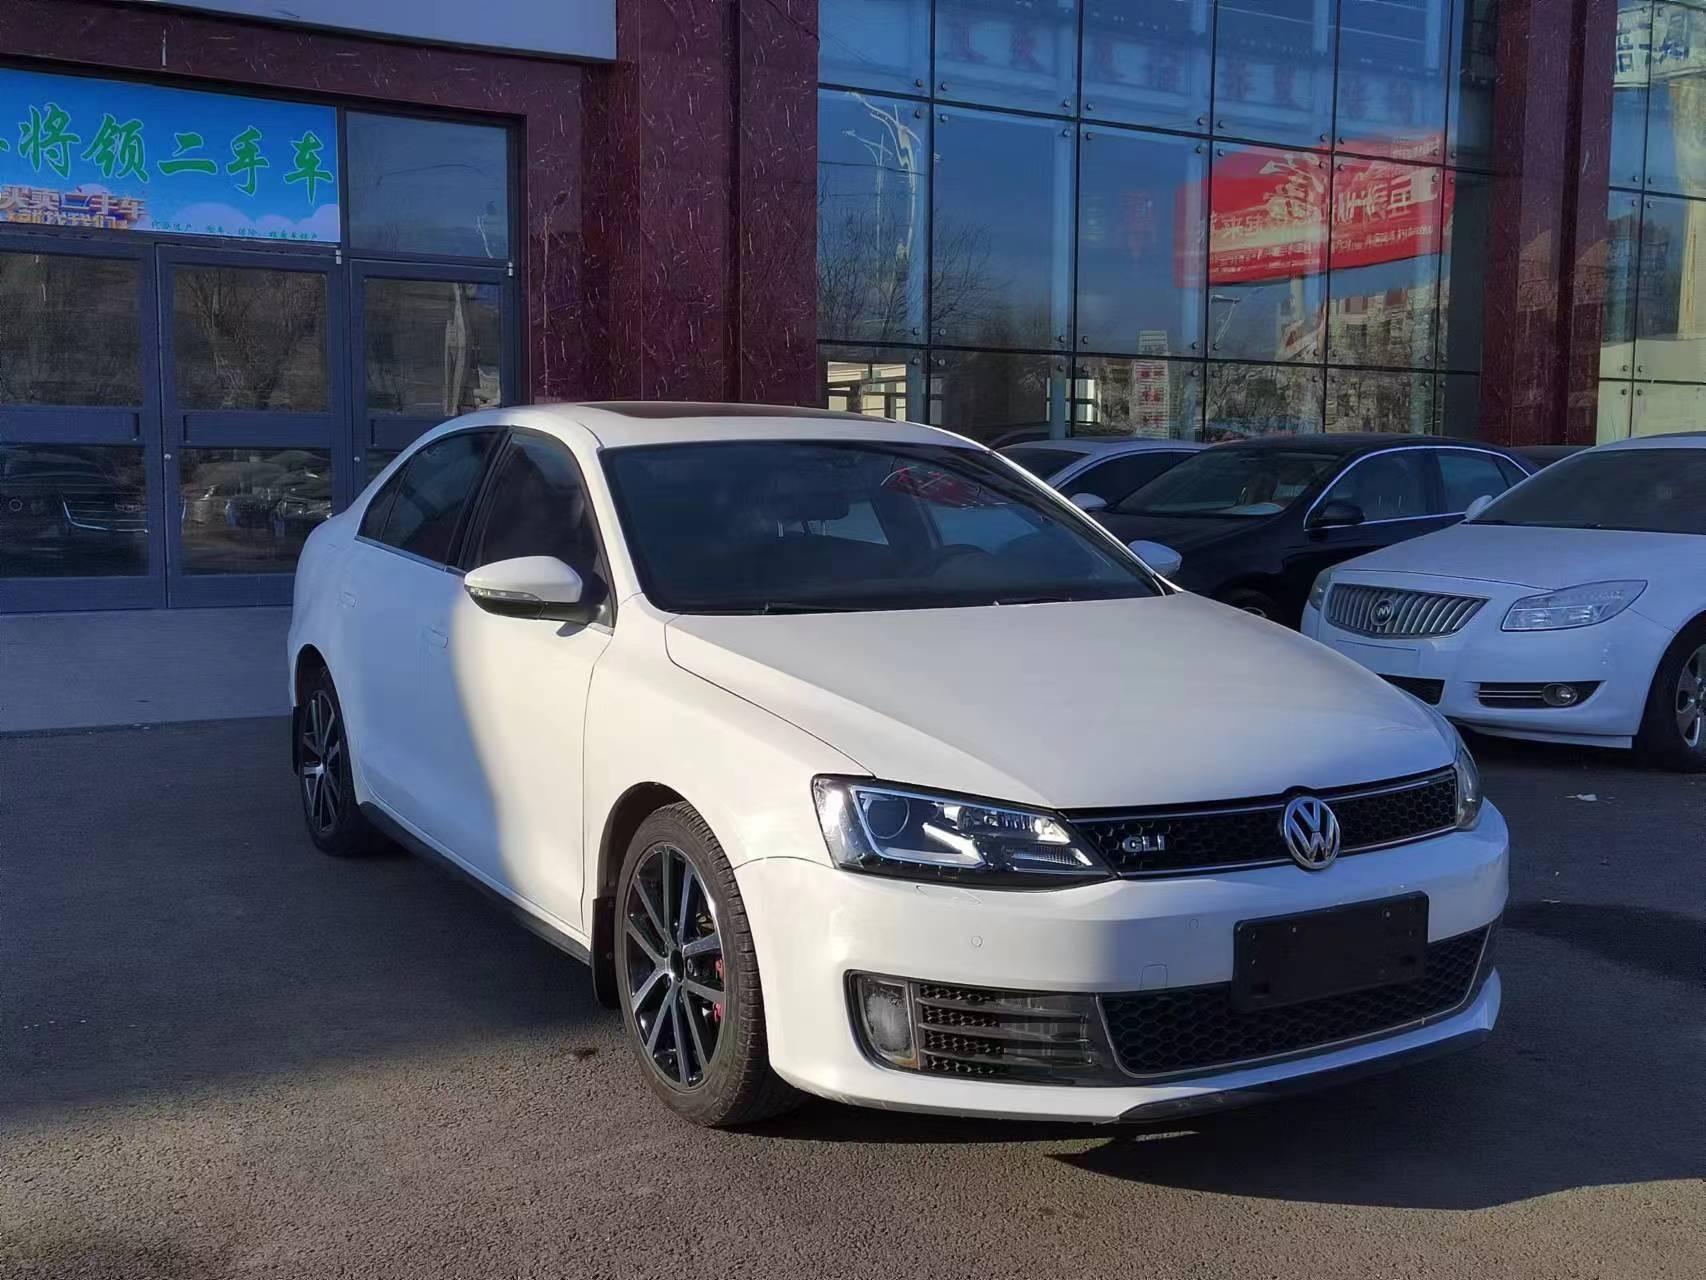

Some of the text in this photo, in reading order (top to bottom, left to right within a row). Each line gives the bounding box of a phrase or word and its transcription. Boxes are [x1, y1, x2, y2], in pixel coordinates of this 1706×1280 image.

[0, 102, 334, 204] 将领二手车
[1122, 834, 1166, 852] GLI
